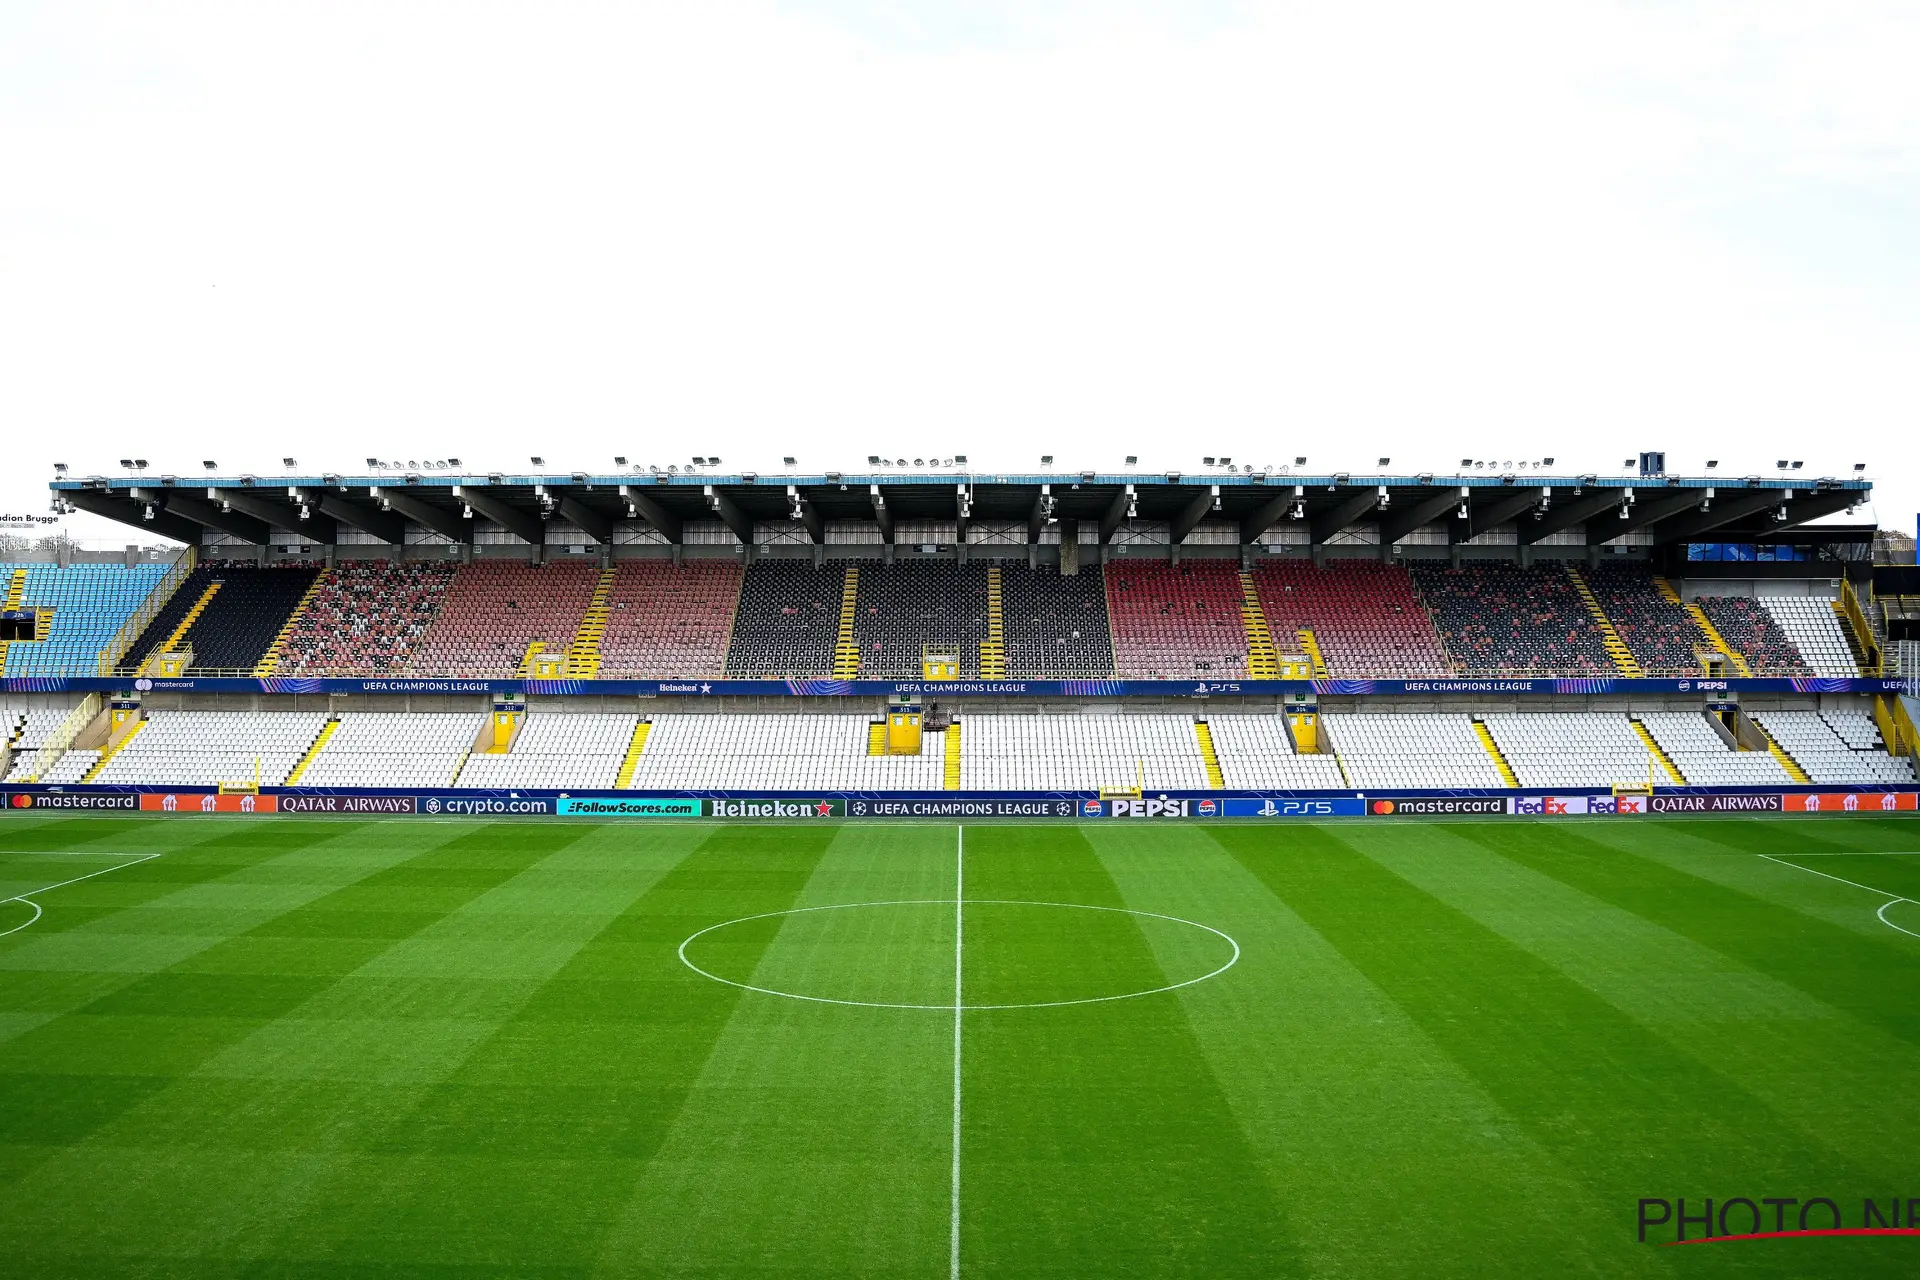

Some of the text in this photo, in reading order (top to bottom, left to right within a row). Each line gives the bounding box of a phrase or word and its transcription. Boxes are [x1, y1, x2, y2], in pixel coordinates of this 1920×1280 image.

[0, 513, 59, 524] dion Brugge
[363, 682, 489, 691] UEFA CHAMPIONS LEAGUE
[659, 683, 698, 692] Heineken
[895, 683, 1026, 692] UEFA CHAMPIONS LEAGUE
[1405, 682, 1532, 691] UEFA CHAMPIONS LEAGUE
[1697, 681, 1727, 690] PEPSI
[1882, 681, 1908, 689] UEFA
[36, 795, 134, 809] mastercard
[283, 797, 410, 813] QATAR AIRWAYS
[446, 799, 547, 814] crypto.com
[568, 802, 692, 813] FollowScores.com
[1283, 801, 1332, 813] PS5
[1399, 799, 1501, 813] mastercard
[1514, 797, 1568, 814] FedEx
[1586, 796, 1640, 814] FedEx
[1652, 796, 1778, 812] QATAR AIRWAYS
[712, 800, 813, 817] Heineken
[874, 803, 1049, 814] UEFA CHAMPIONS LEAGUE
[1112, 800, 1188, 817] PEPSI
